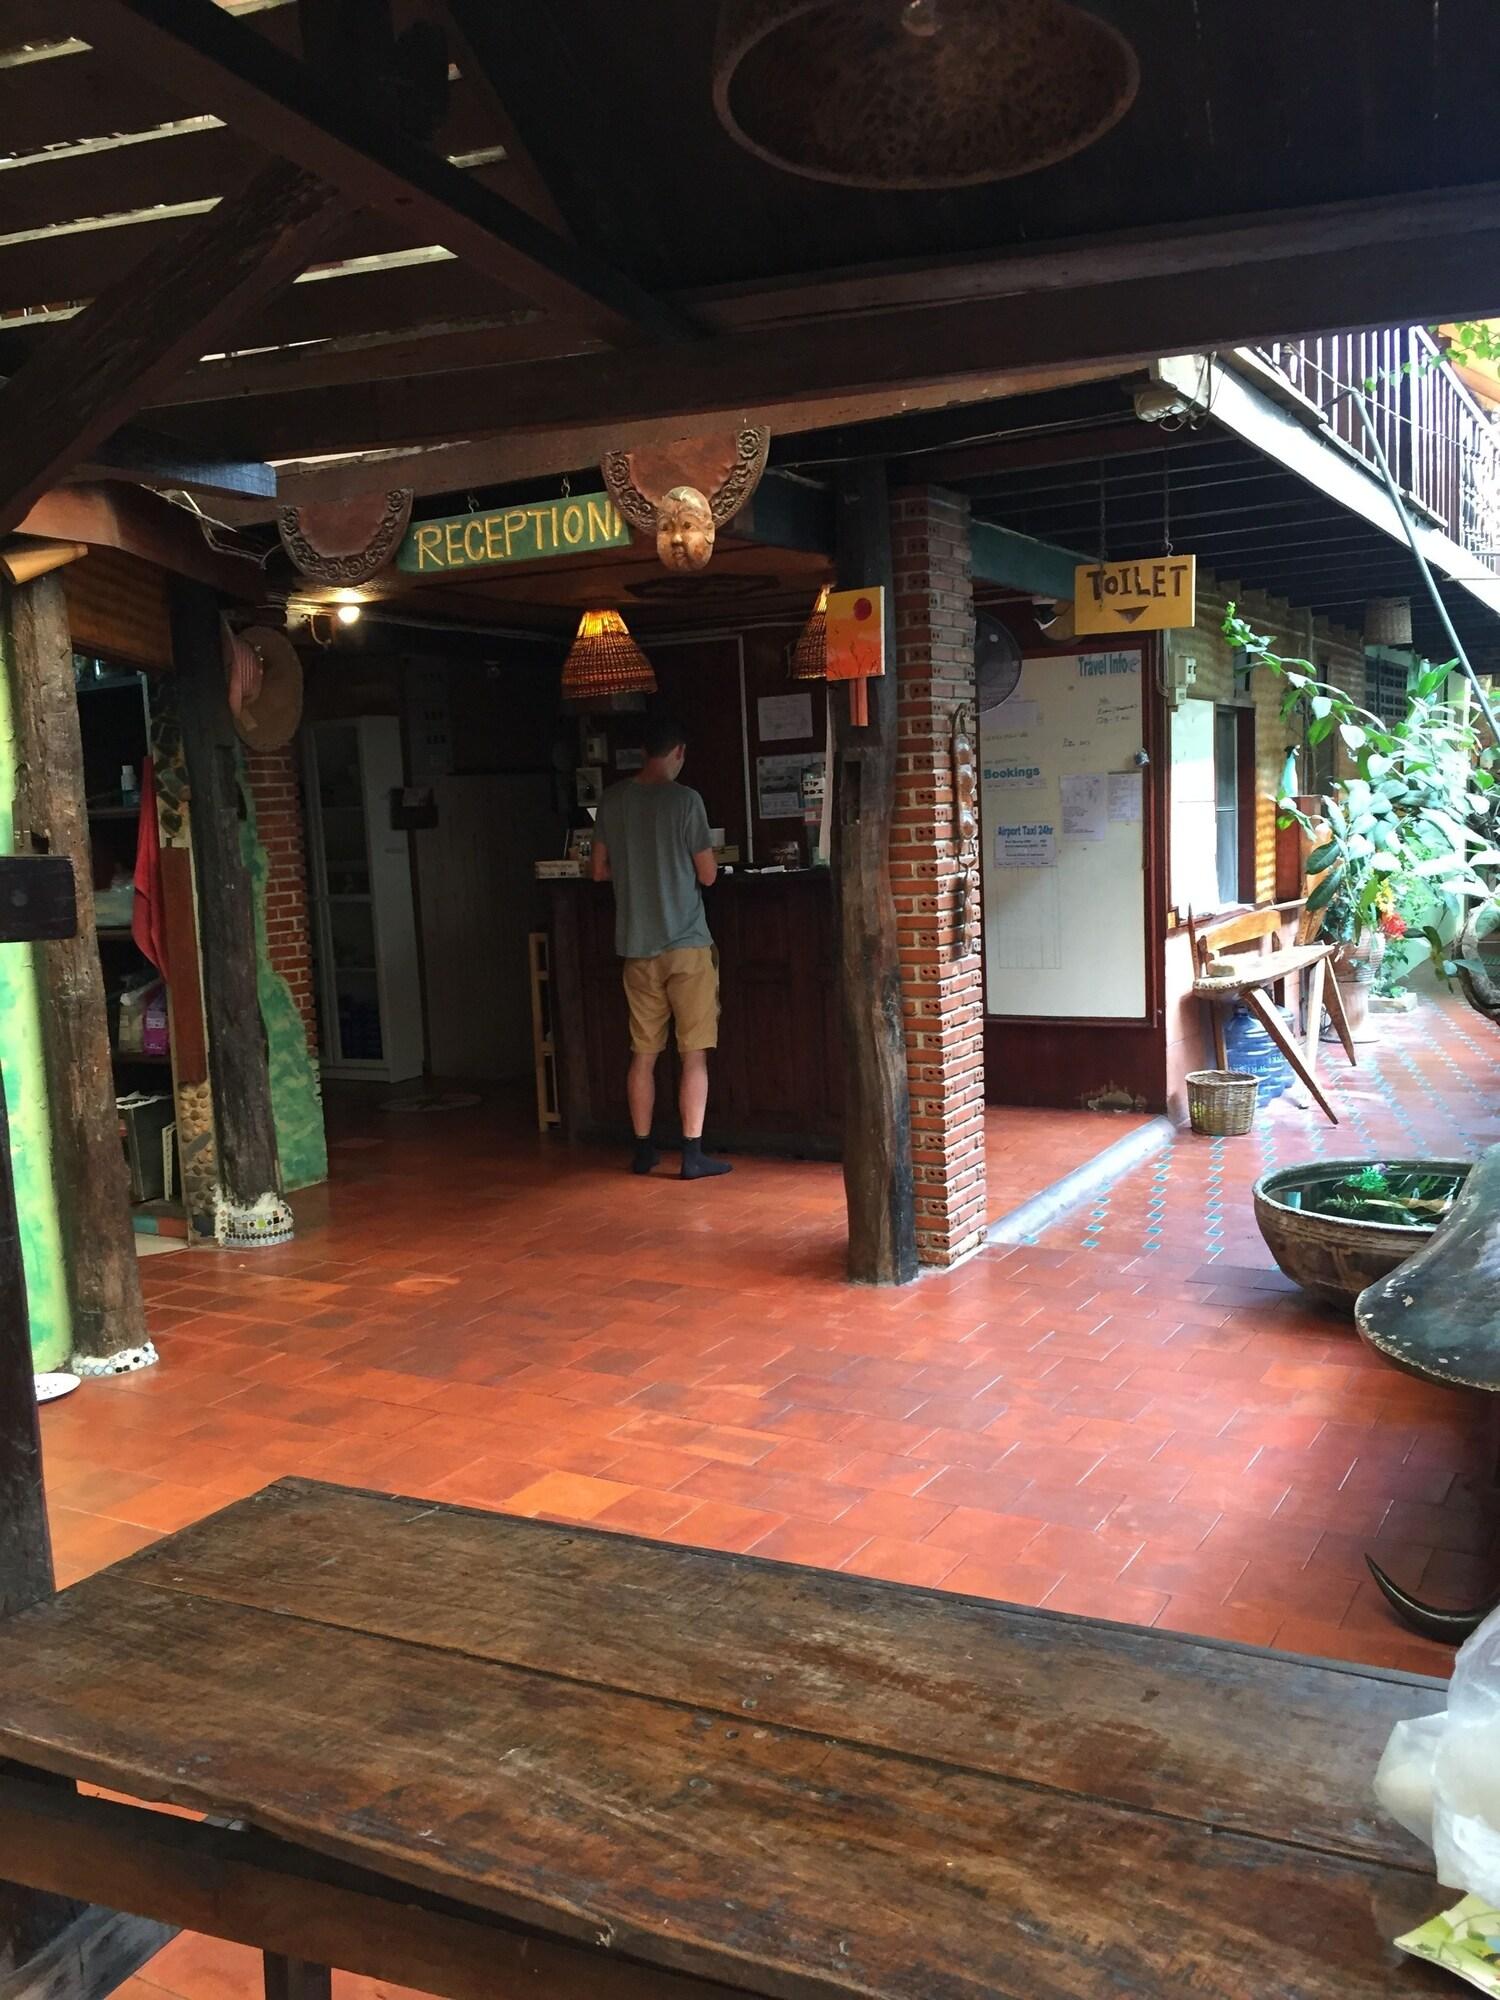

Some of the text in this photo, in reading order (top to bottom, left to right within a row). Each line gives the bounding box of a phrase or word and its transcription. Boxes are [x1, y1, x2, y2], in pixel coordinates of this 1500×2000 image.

[1078, 652, 1128, 677] Travel Info
[983, 766, 1040, 780] Bookings
[998, 825, 1021, 840] Airport
[1022, 824, 1037, 837] Taxi
